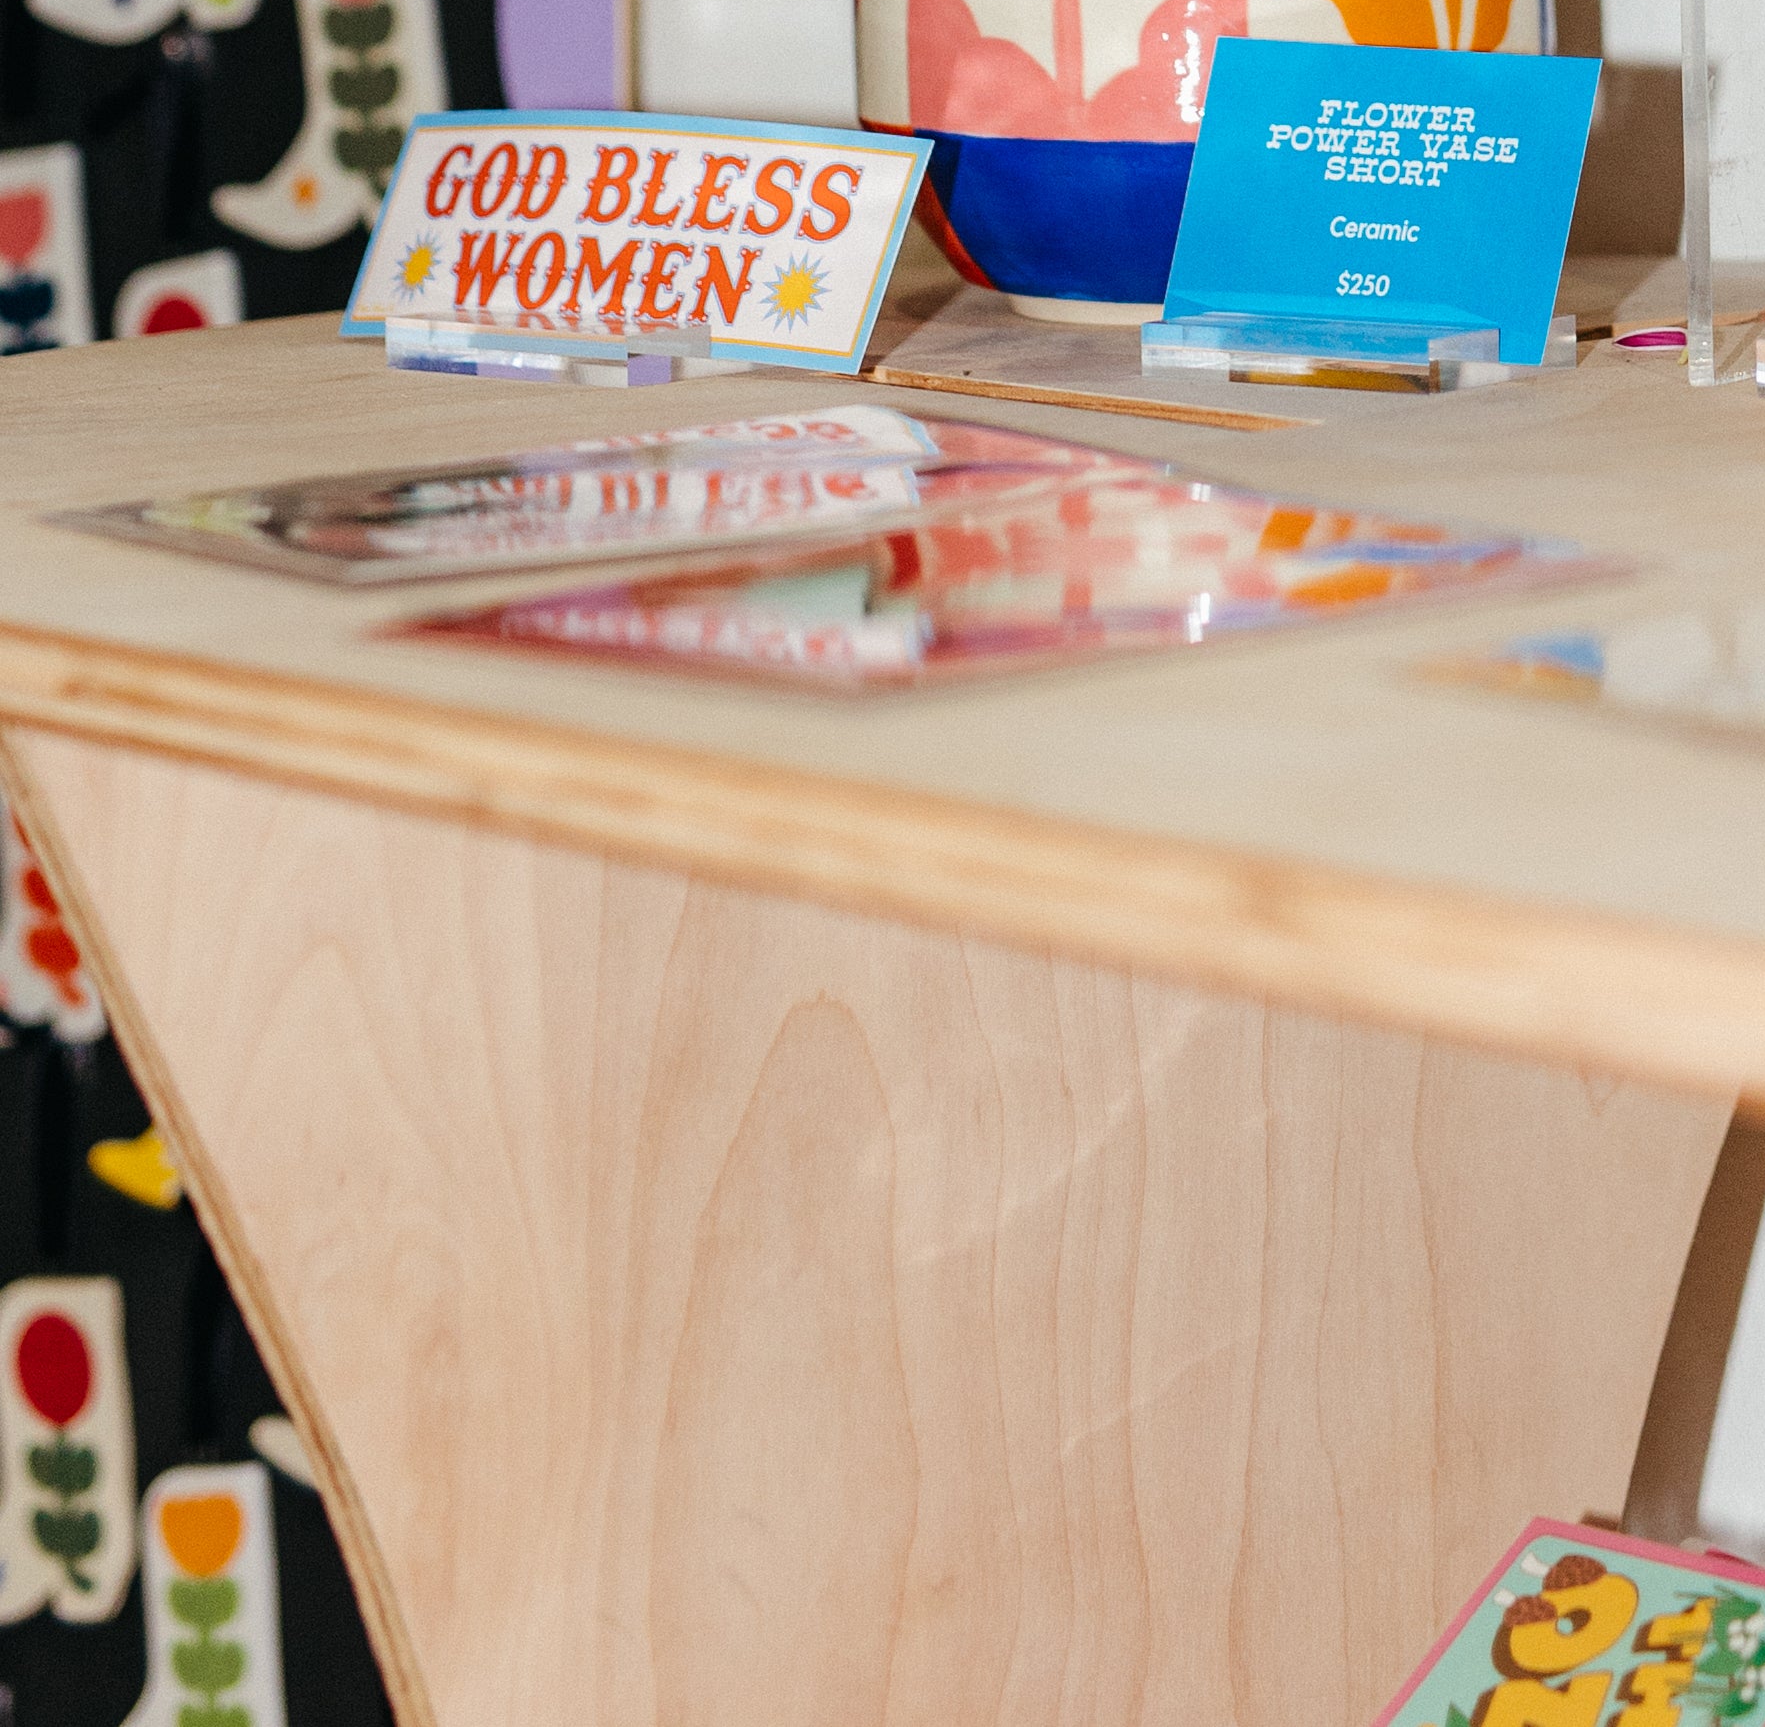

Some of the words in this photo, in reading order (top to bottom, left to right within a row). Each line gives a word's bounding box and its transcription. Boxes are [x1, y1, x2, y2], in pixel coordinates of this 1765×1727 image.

[1317, 99, 1476, 133] FLOWER
[1266, 124, 1400, 157] POWER
[1419, 132, 1519, 164] VASE
[1324, 156, 1448, 187] SHORT
[425, 141, 568, 220] GOD
[577, 145, 863, 243] BLESS
[1330, 215, 1420, 243] Ceramic
[452, 230, 764, 325] WOMEN
[1336, 269, 1391, 297] $250
